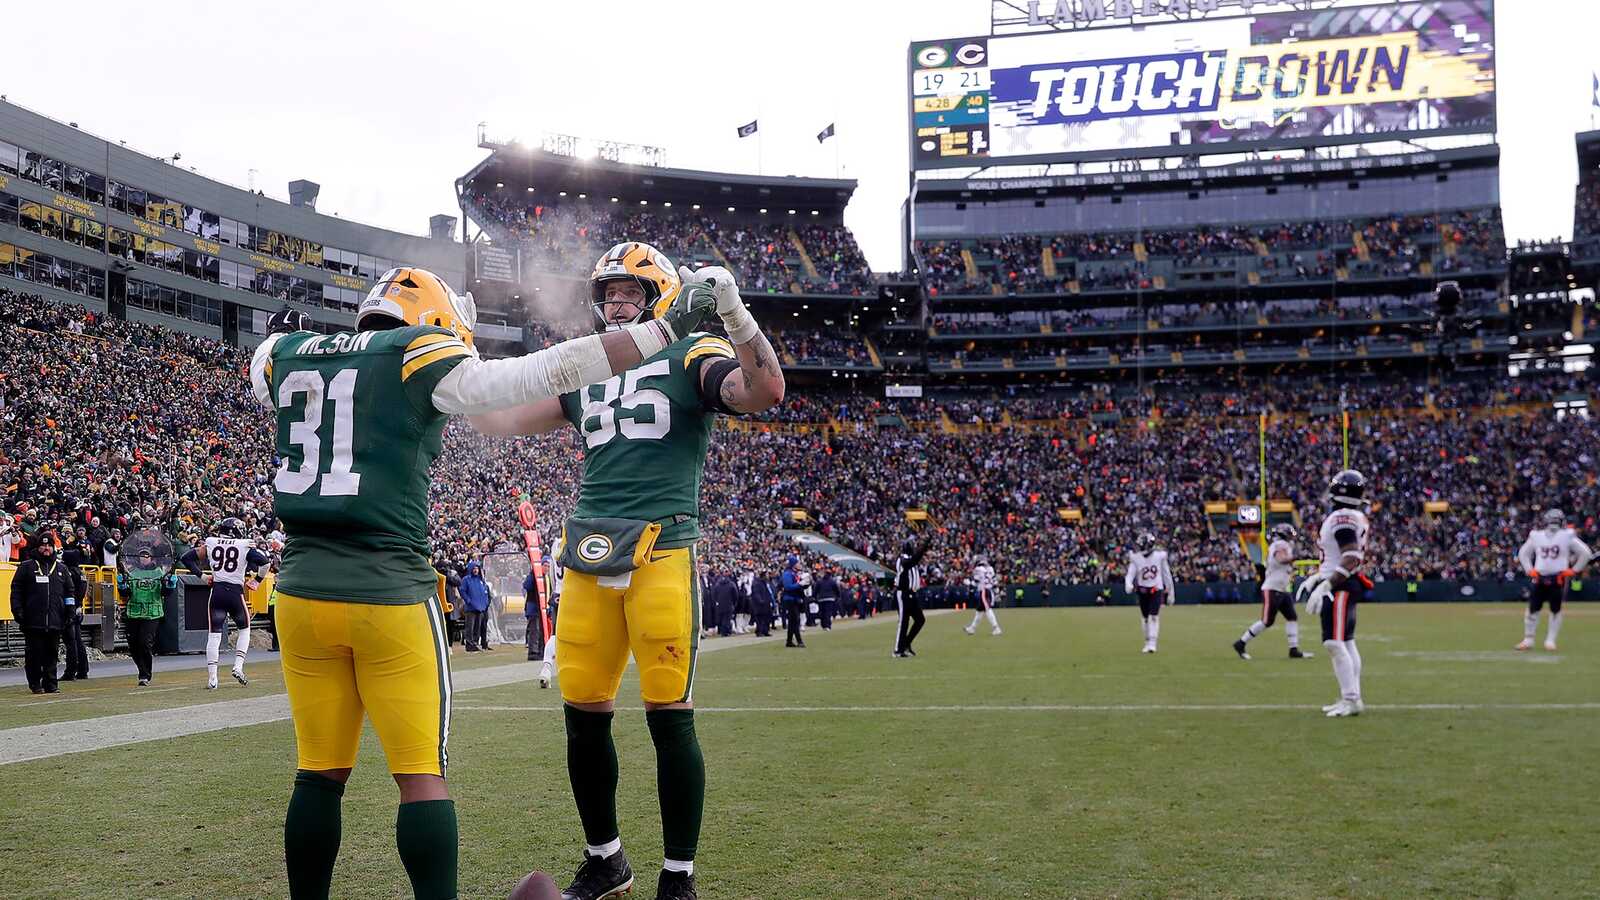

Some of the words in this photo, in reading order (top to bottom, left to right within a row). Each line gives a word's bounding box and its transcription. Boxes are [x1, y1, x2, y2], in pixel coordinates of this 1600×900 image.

[923, 74, 944, 90] 19
[960, 72, 981, 88] 21
[967, 181, 999, 191] WORLD
[1000, 179, 1053, 190] CHAMPIONS
[1065, 177, 1086, 186] 1929
[1093, 175, 1115, 185] 1930
[1121, 174, 1141, 184] 1931
[579, 359, 672, 449] 85
[273, 368, 361, 496] 31
[211, 545, 240, 573] 98
[1141, 565, 1158, 580] 29
